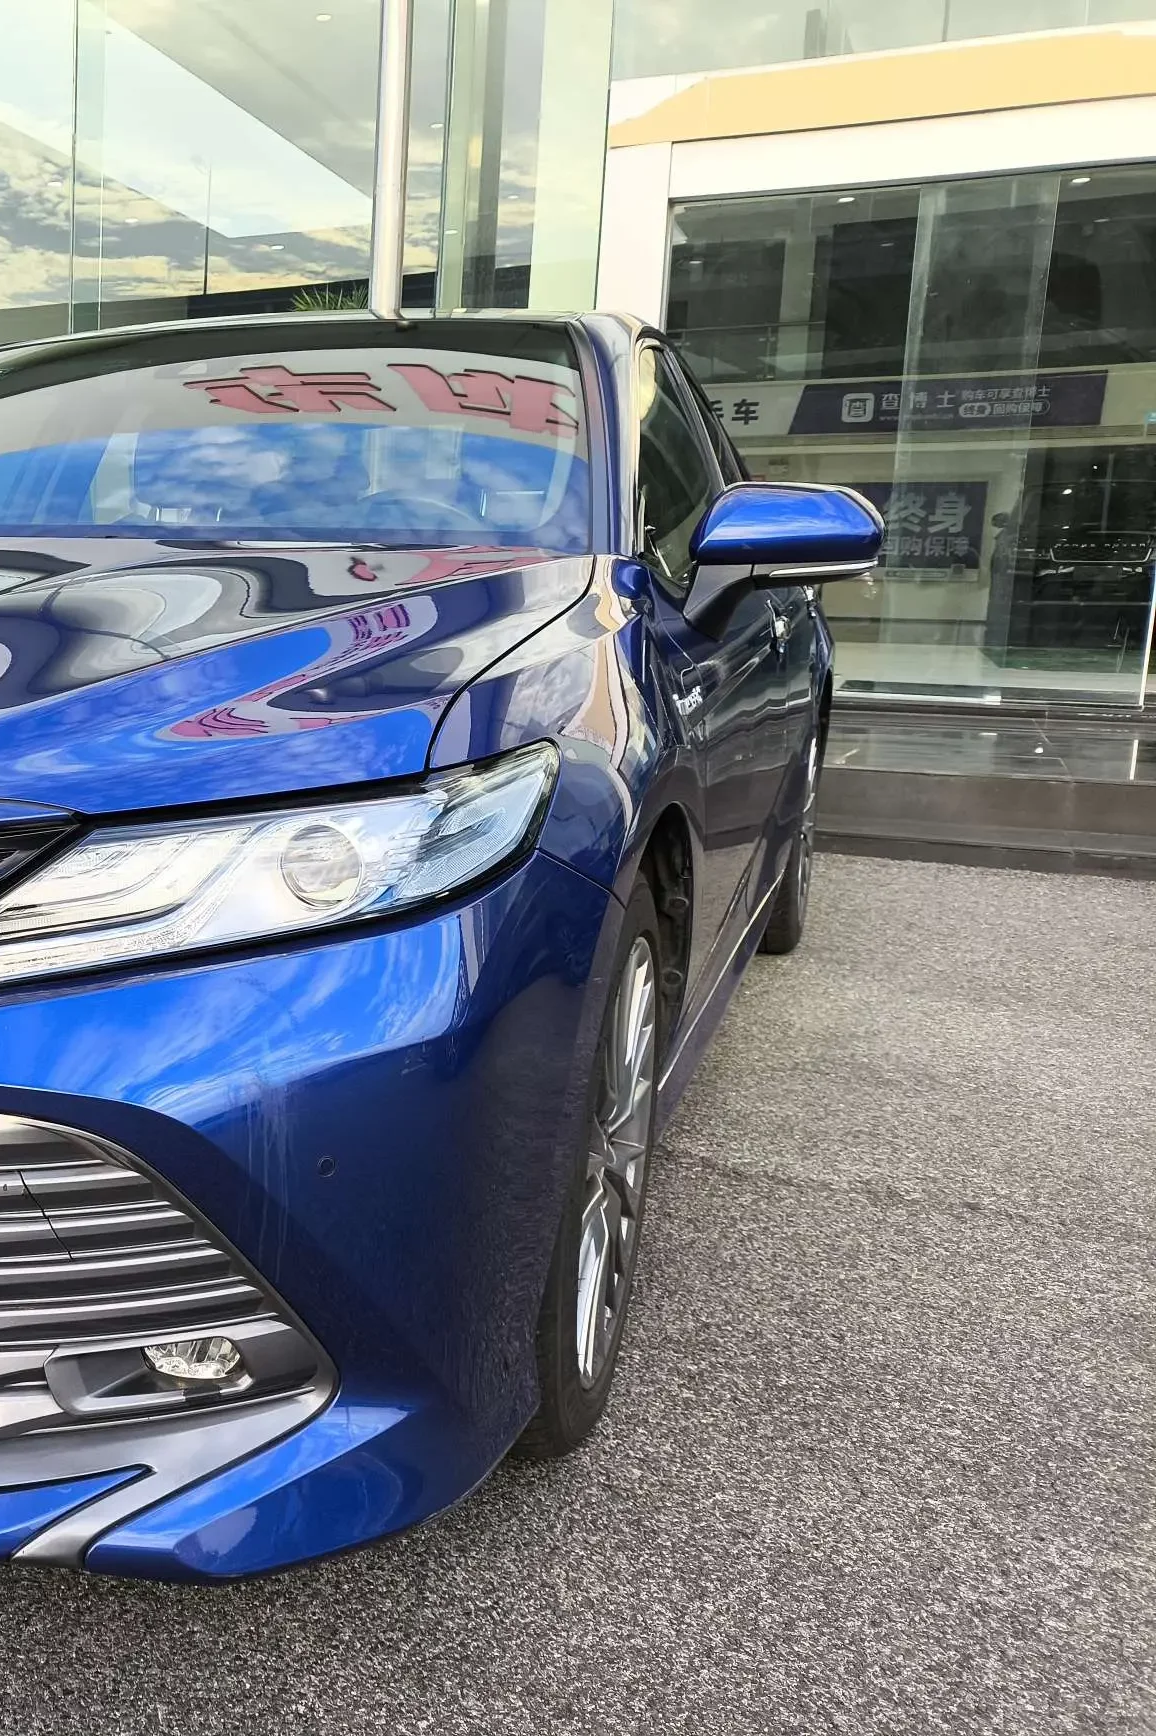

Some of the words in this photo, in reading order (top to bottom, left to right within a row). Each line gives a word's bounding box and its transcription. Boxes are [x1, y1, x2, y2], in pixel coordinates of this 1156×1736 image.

[880, 390, 957, 411] 查博士
[883, 490, 972, 533] 终身
